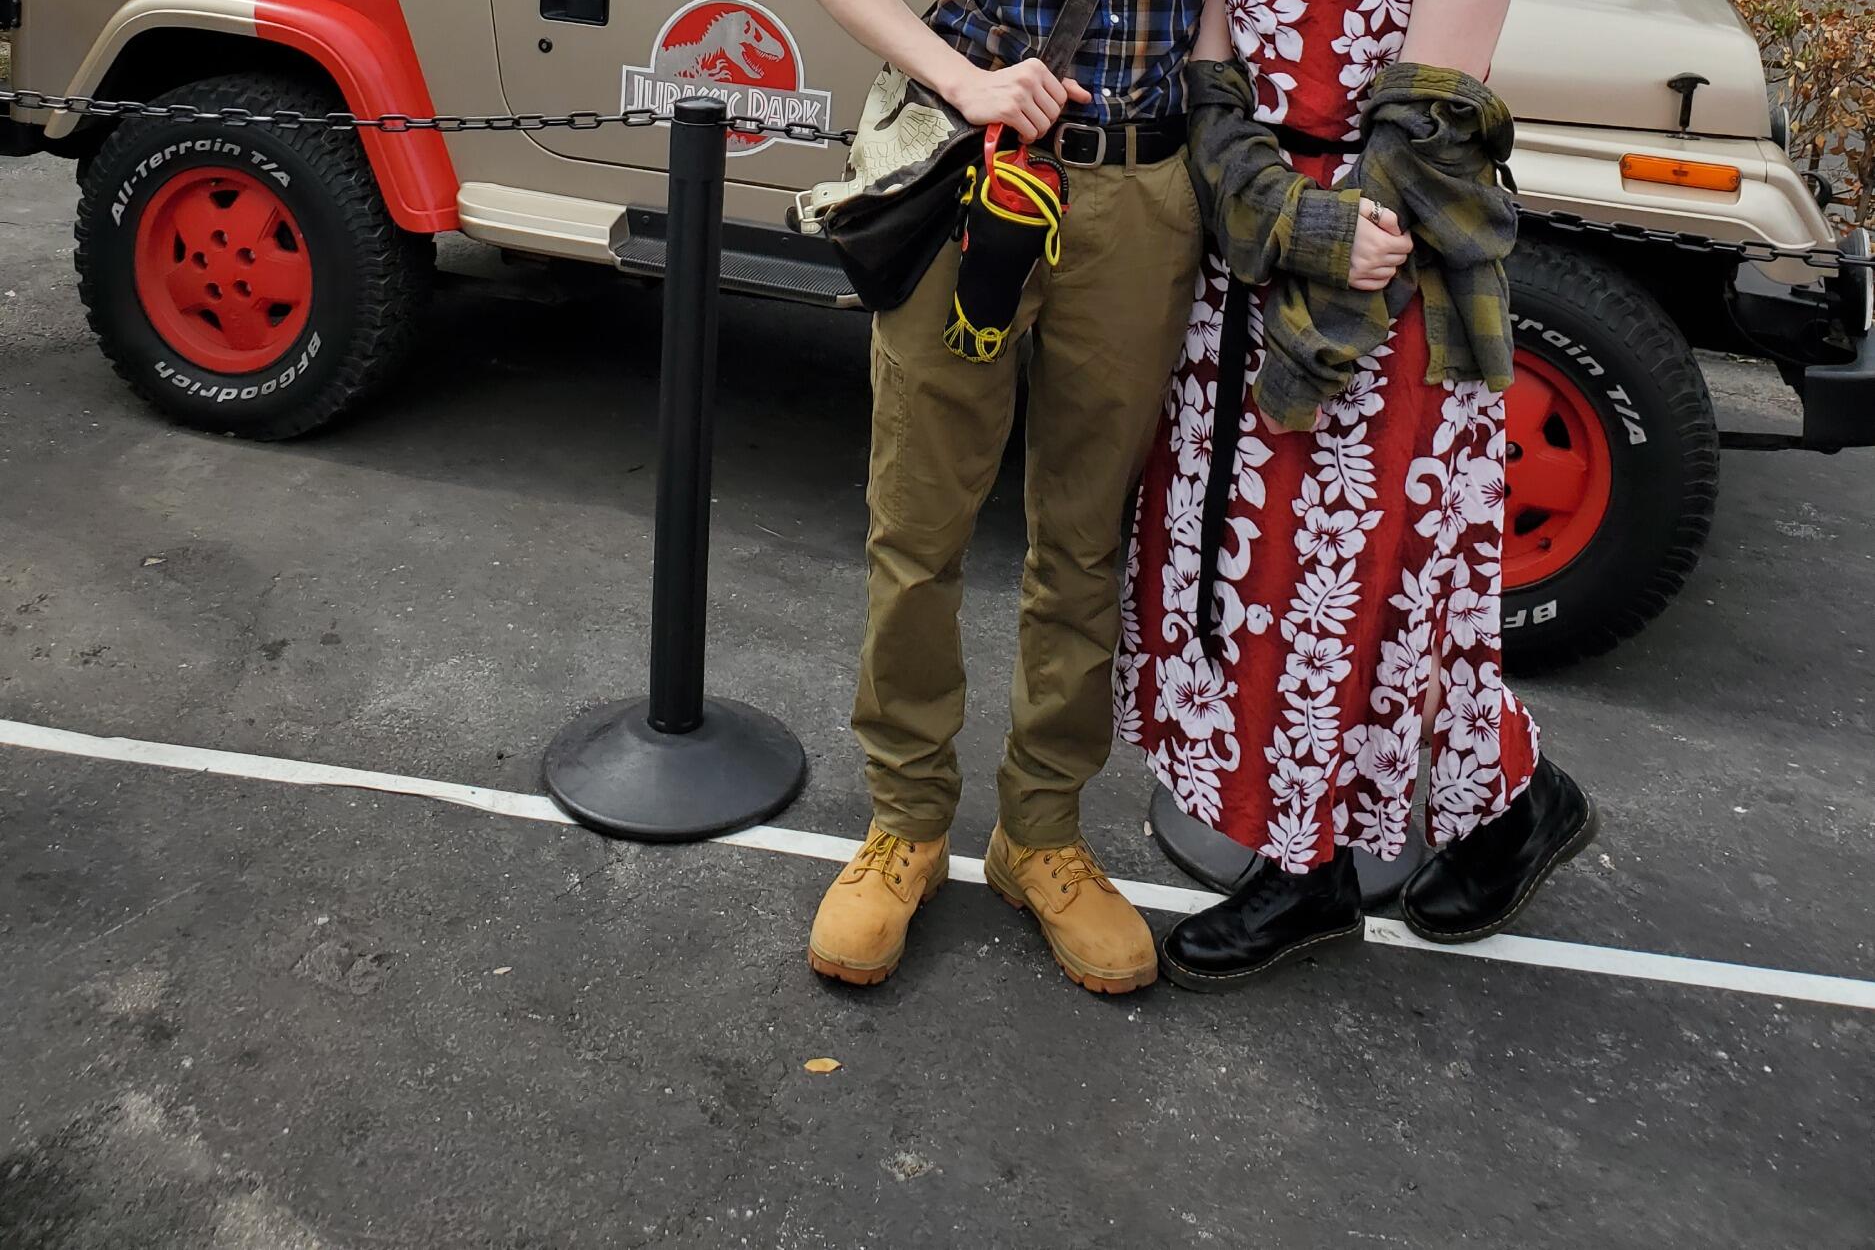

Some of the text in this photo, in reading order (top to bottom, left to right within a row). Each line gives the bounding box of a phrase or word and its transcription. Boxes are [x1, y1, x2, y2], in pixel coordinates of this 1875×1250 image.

[746, 89, 821, 133] PARK
[110, 138, 291, 227] All-Terrain T/A
[1607, 384, 1647, 445] T/A
